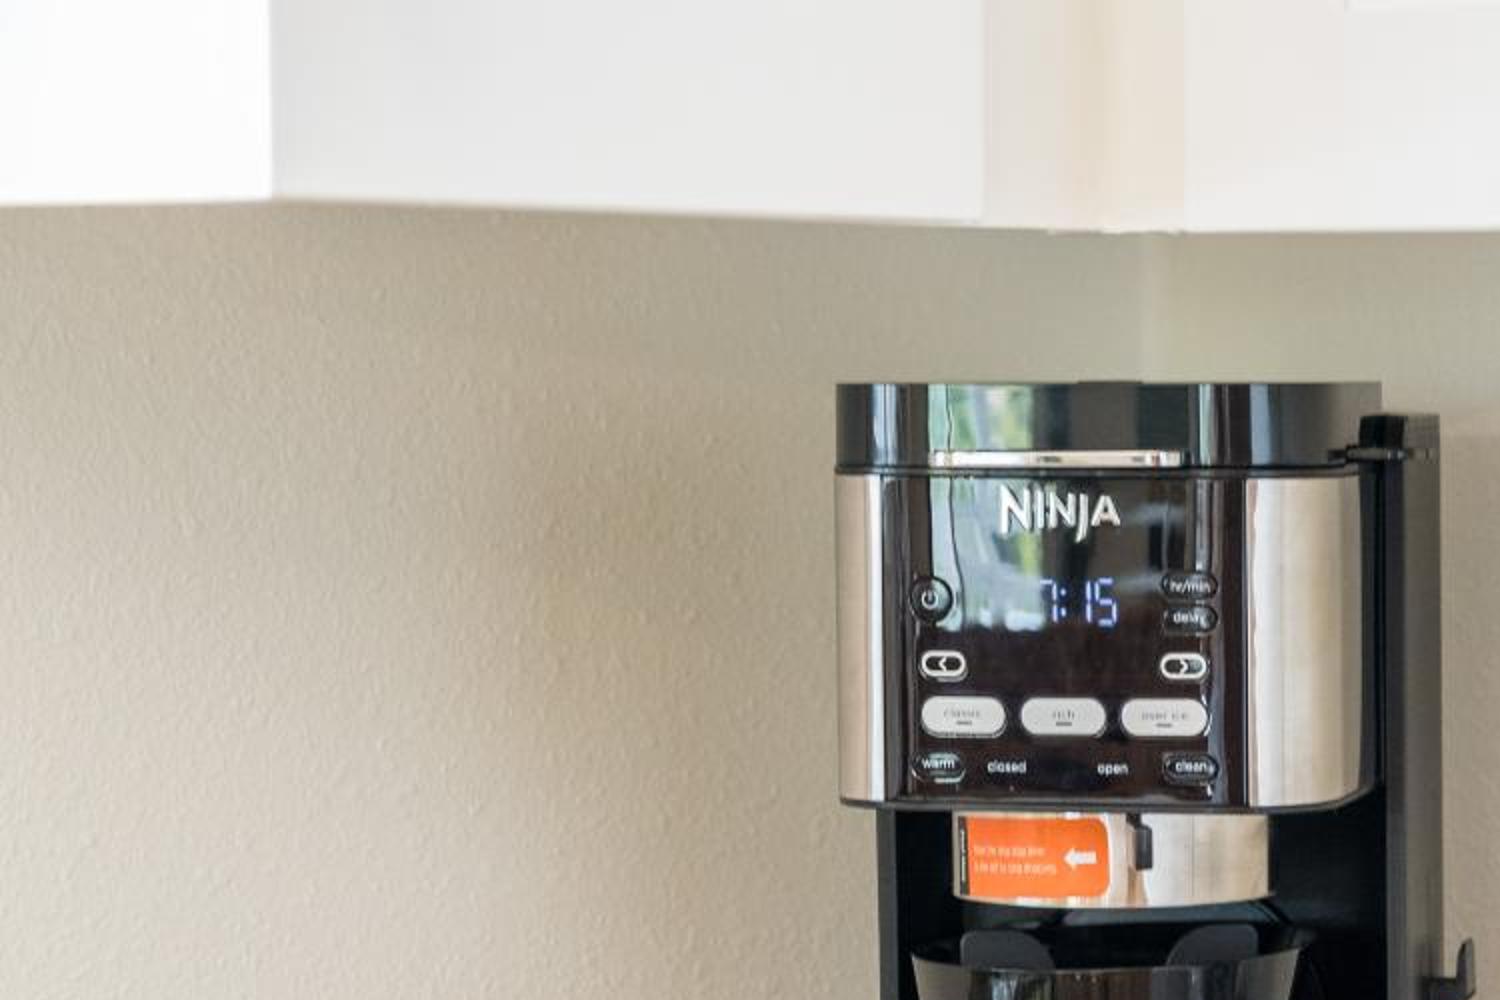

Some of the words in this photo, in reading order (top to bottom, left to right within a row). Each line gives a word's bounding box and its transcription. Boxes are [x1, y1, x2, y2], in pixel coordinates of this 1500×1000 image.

[1000, 484, 1121, 542] NINJA
[1040, 577, 1118, 627] 7:15
[921, 759, 955, 769] warm
[987, 760, 1027, 774] closed
[1097, 763, 1129, 776] open
[1175, 761, 1207, 773] clean
